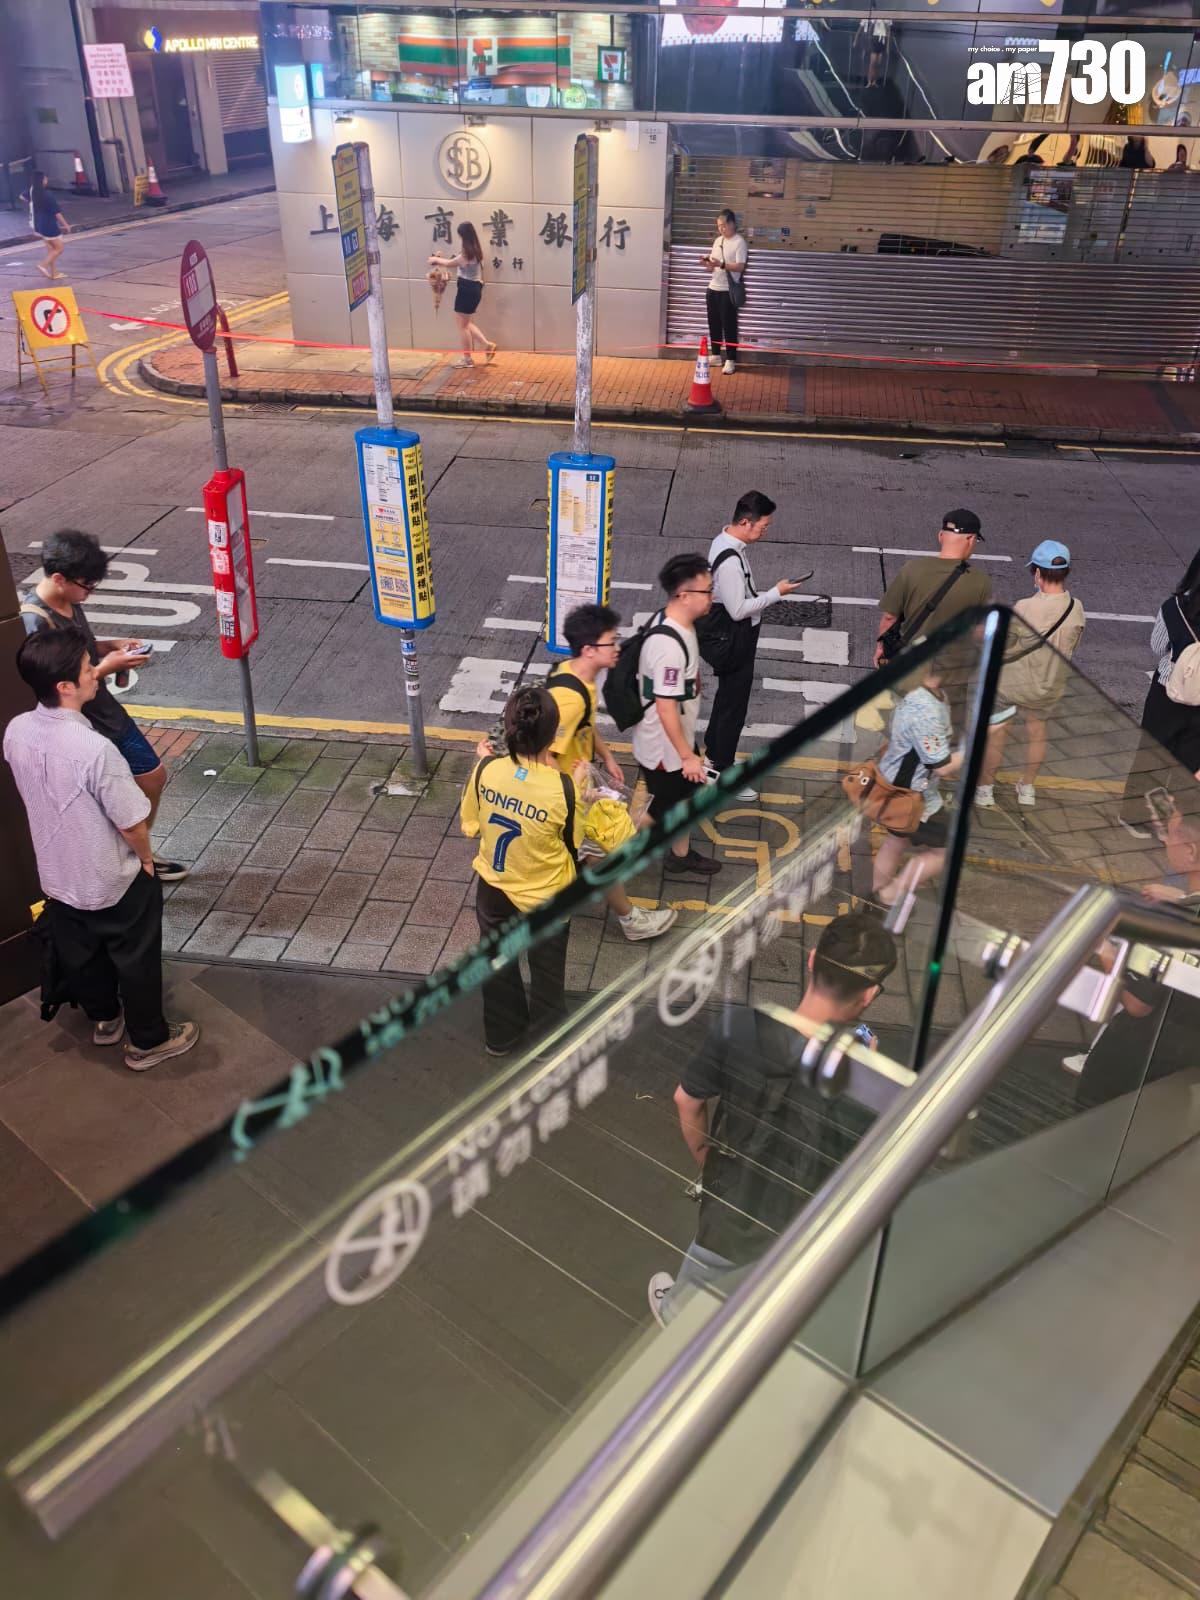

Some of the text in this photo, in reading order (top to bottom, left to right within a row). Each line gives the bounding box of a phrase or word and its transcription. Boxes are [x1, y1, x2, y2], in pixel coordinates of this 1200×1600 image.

[165, 38, 205, 52] APOLLO
[223, 36, 258, 49] CENTRE
[488, 812, 522, 872] 7
